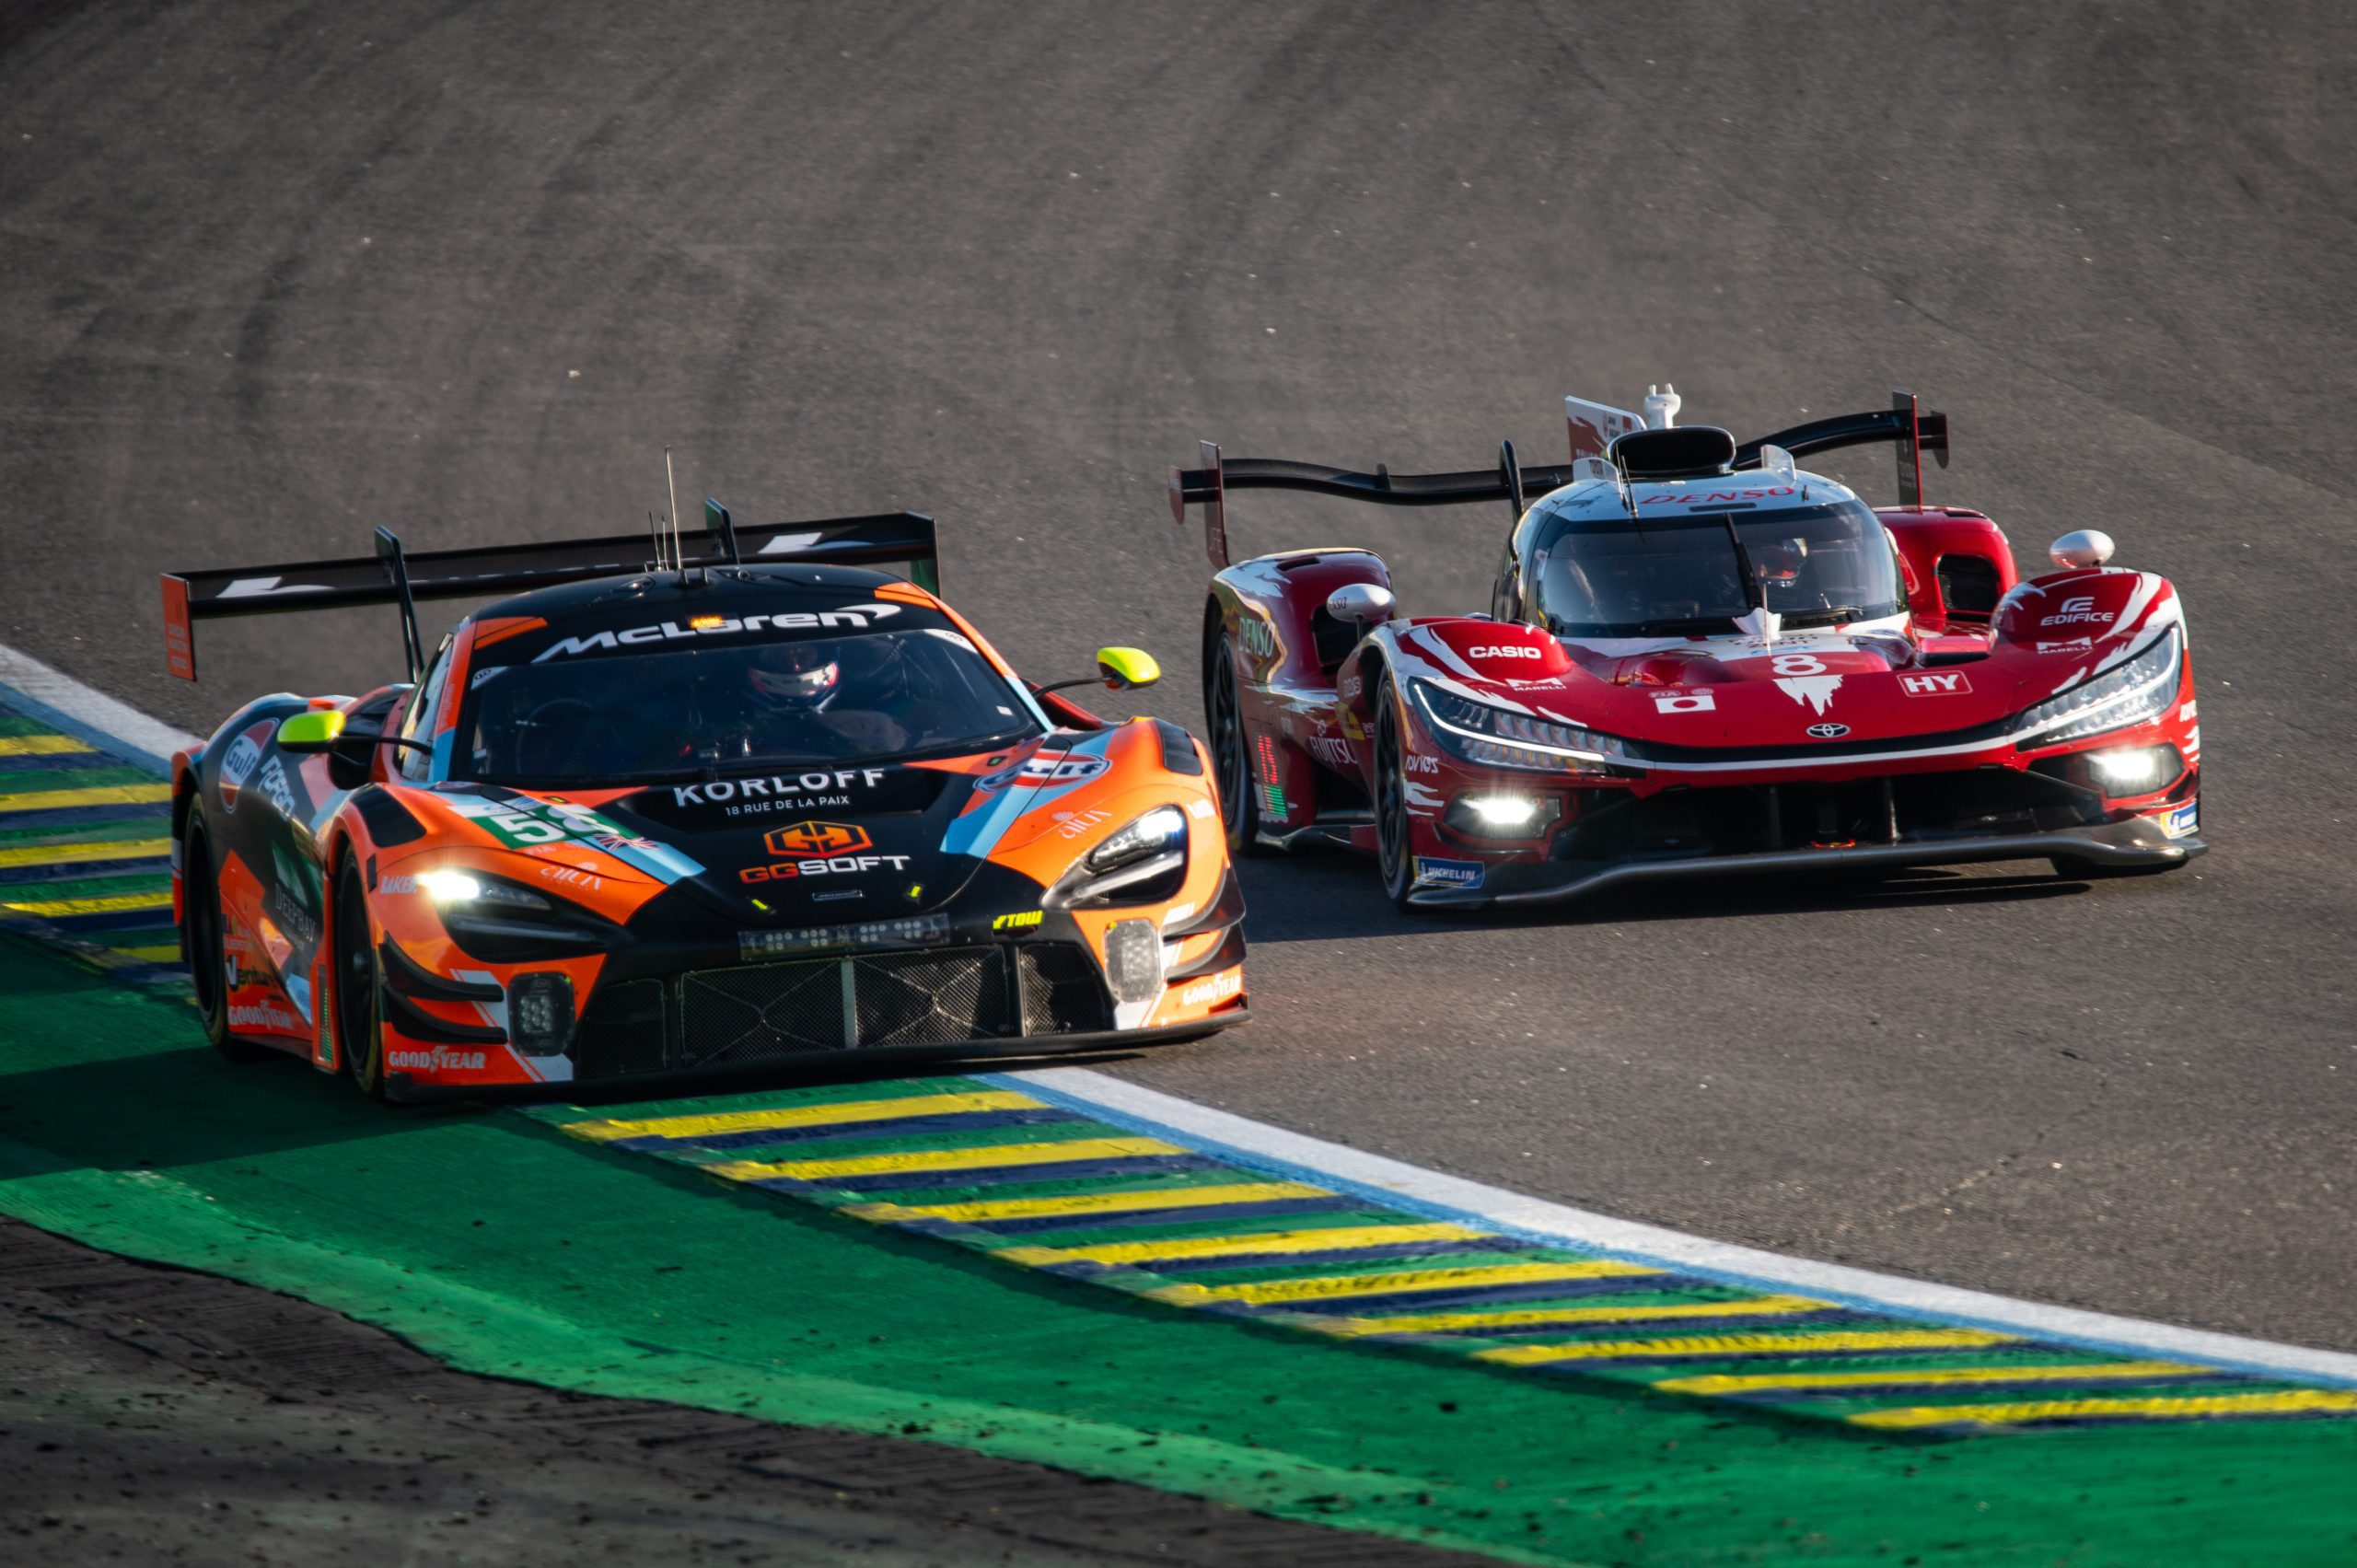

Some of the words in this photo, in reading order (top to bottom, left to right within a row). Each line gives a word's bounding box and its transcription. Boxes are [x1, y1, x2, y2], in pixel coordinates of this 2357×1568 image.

[1640, 486, 1794, 505] DENSO
[2039, 611, 2115, 626] EDIFICE
[530, 611, 869, 664] McLaren
[1237, 617, 1275, 658] DENSO
[1468, 645, 1542, 659] CASIO
[2037, 645, 2093, 655] MARELLI
[1771, 654, 1828, 676] 8
[1903, 673, 1959, 693] HY
[674, 768, 886, 807] KORLOFF
[726, 807, 740, 817] 18
[744, 801, 772, 814] RUE
[775, 798, 794, 810] DE
[797, 797, 816, 807] LA
[819, 795, 850, 806] PAIX
[739, 854, 911, 884] GGSOFT
[1428, 866, 1476, 880] MICHELIN
[1007, 910, 1043, 926] TOW
[388, 1045, 486, 1073] GOODYEAR
